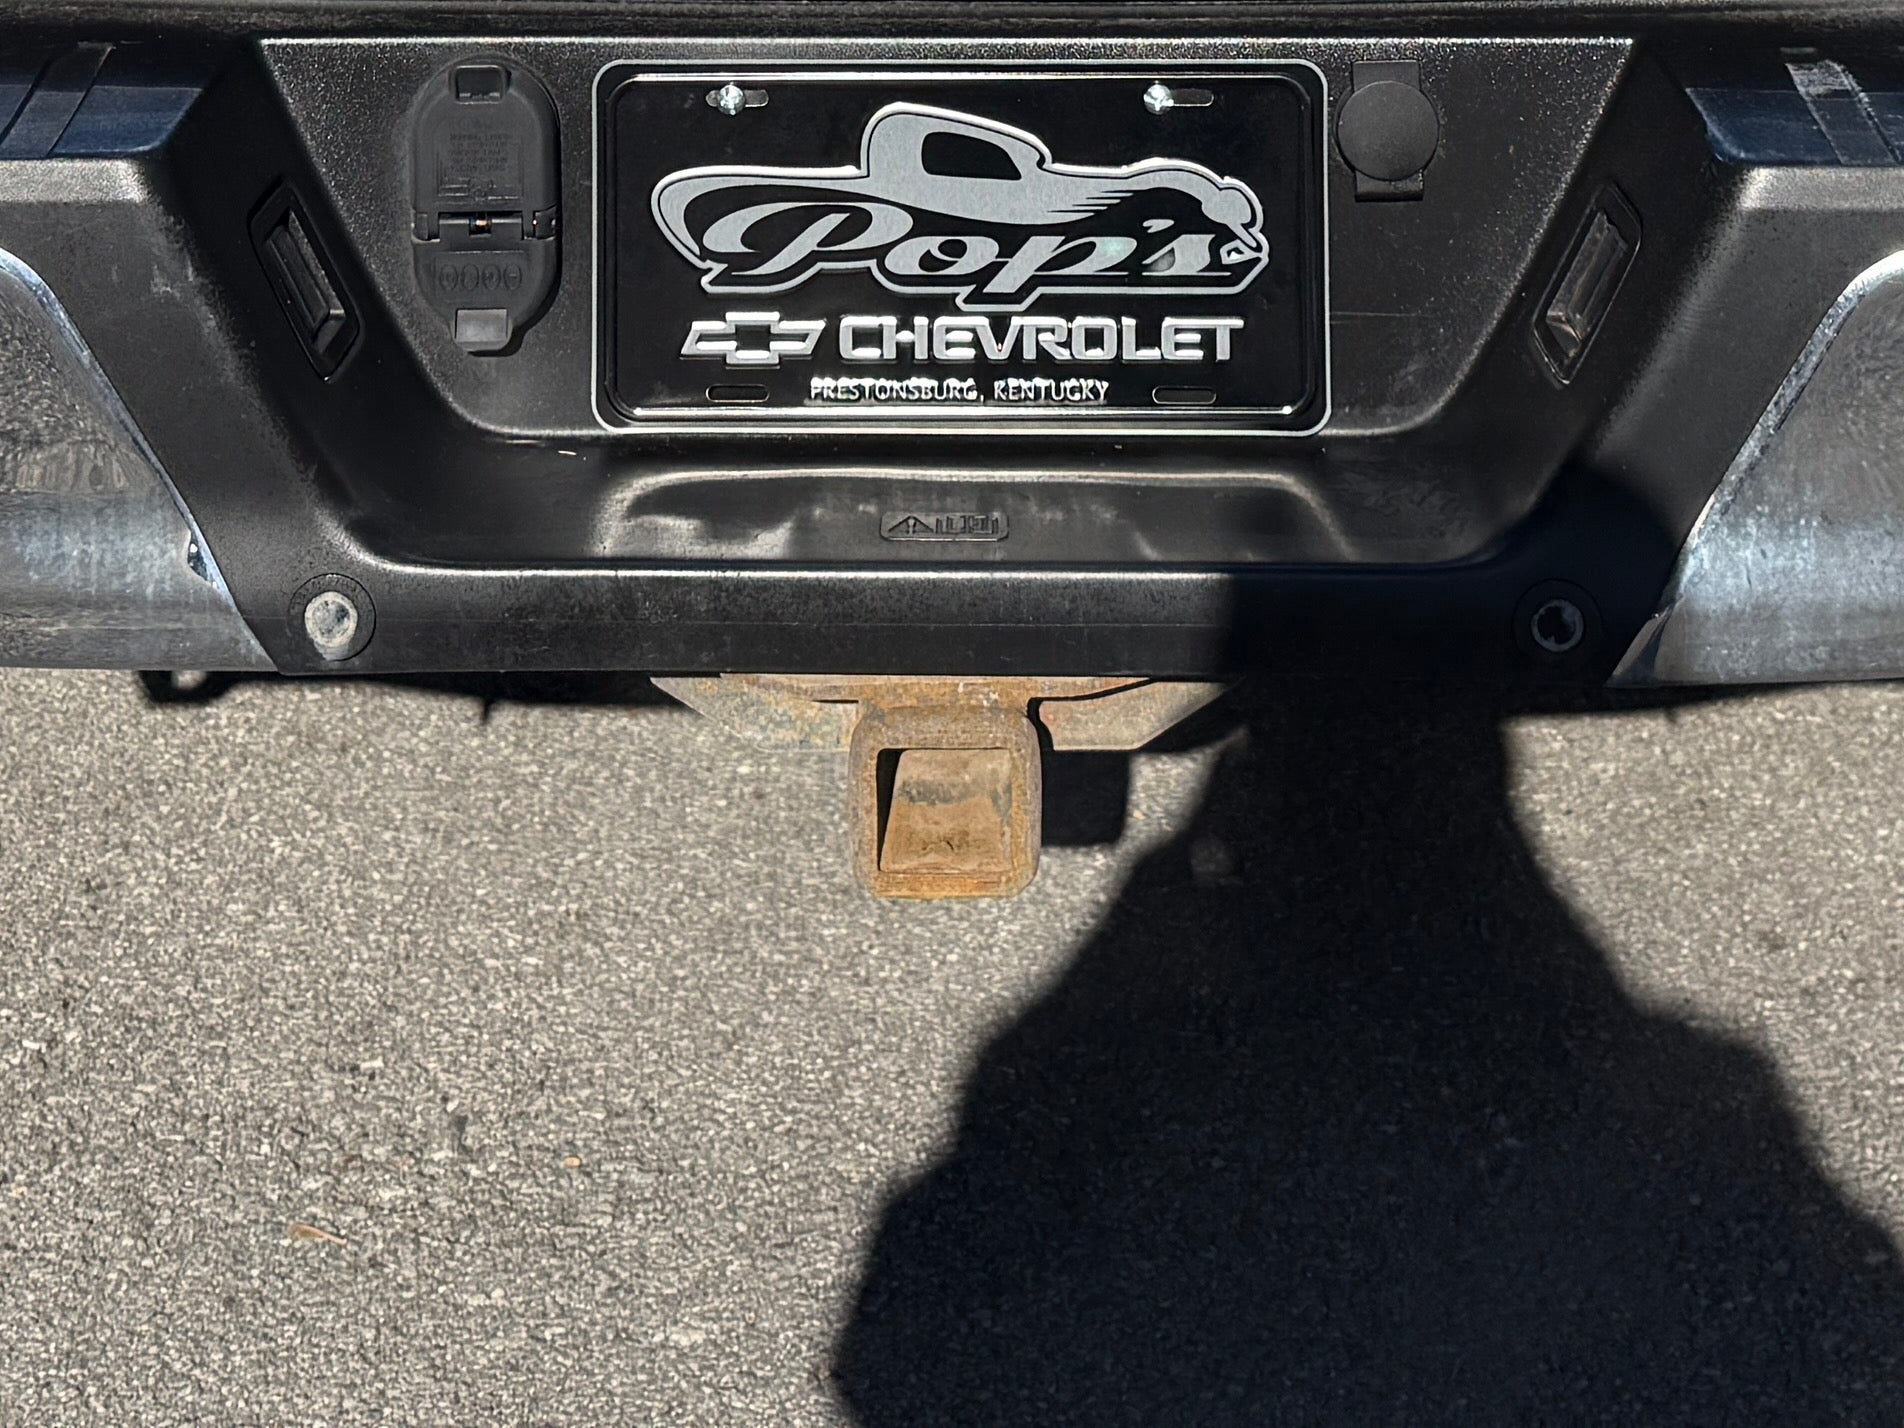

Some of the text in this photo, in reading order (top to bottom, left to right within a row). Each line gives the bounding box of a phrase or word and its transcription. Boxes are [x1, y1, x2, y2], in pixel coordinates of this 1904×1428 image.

[701, 200, 1234, 294] Pop's
[839, 315, 1246, 363] CHEVROLET
[809, 376, 1110, 404] PRESTONSBURG, KENTUCKY
